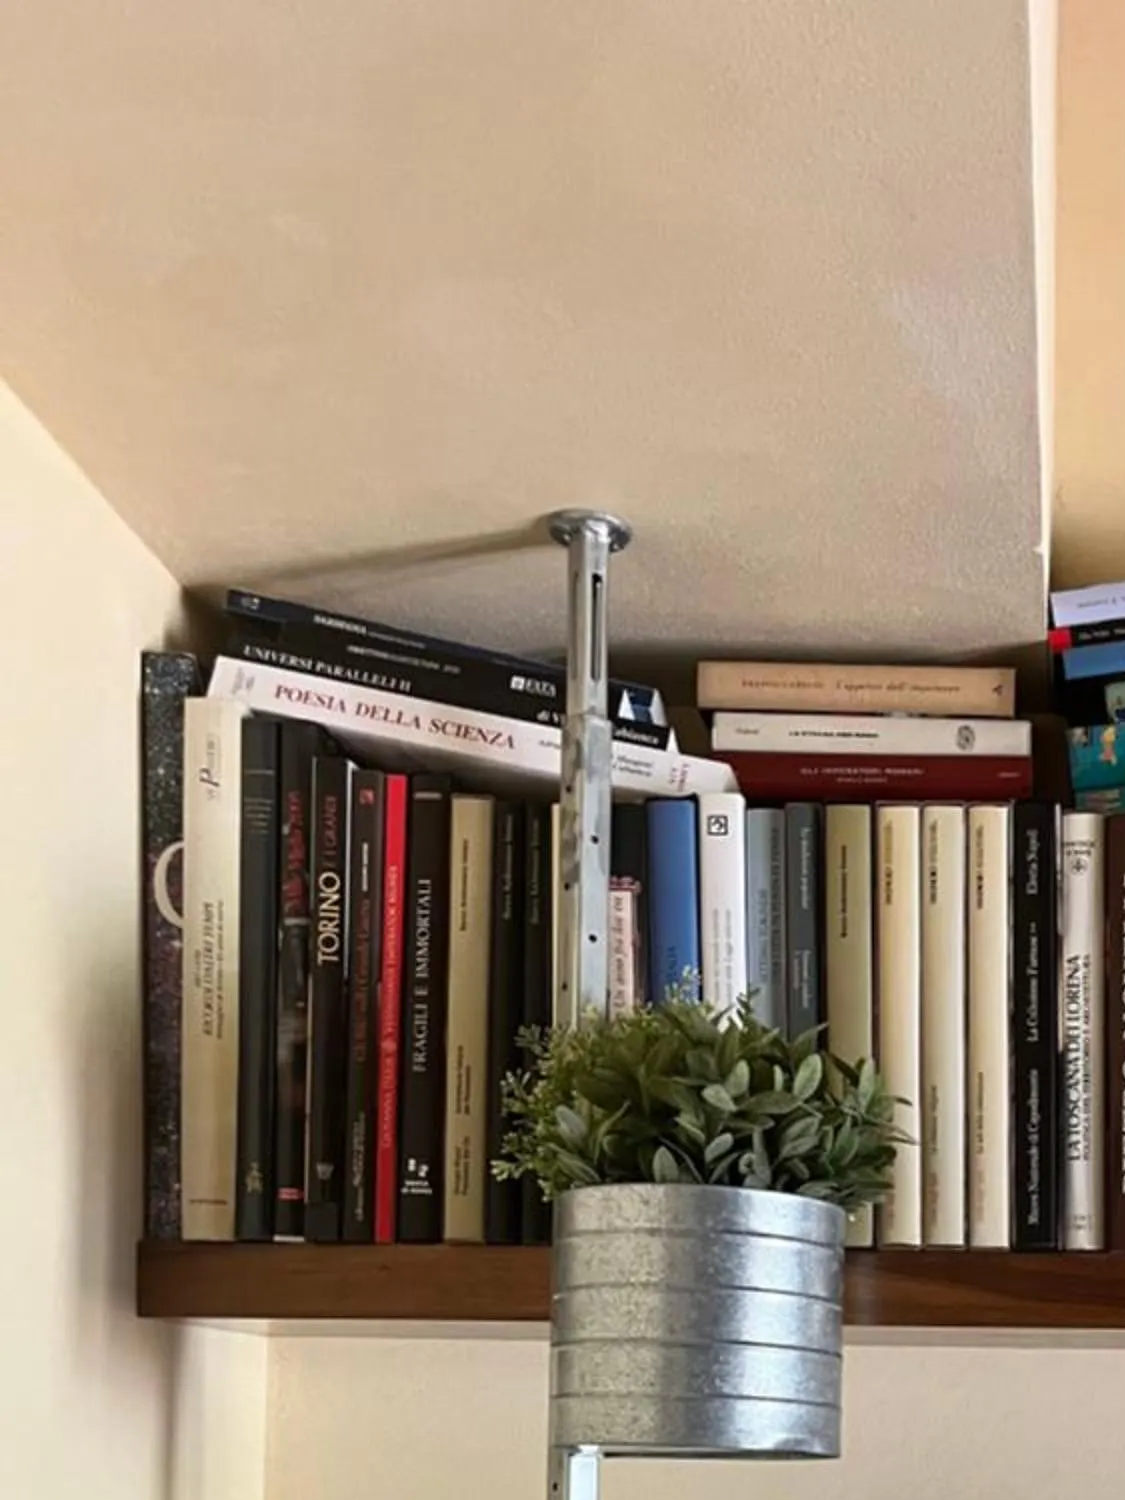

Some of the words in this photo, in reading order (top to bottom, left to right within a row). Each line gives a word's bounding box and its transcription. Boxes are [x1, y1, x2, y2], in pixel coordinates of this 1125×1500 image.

[243, 644, 313, 671] UNIVERSI
[314, 661, 398, 692] PARALLELI
[276, 684, 347, 715] POESIA
[355, 702, 421, 731] DELLA
[428, 718, 515, 751] SCIENZA
[318, 872, 340, 966] TORINO
[414, 878, 432, 978] IMMORTALI
[414, 984, 429, 996] E
[1066, 954, 1081, 1022] LORENA
[412, 1004, 429, 1073] FRAGILI
